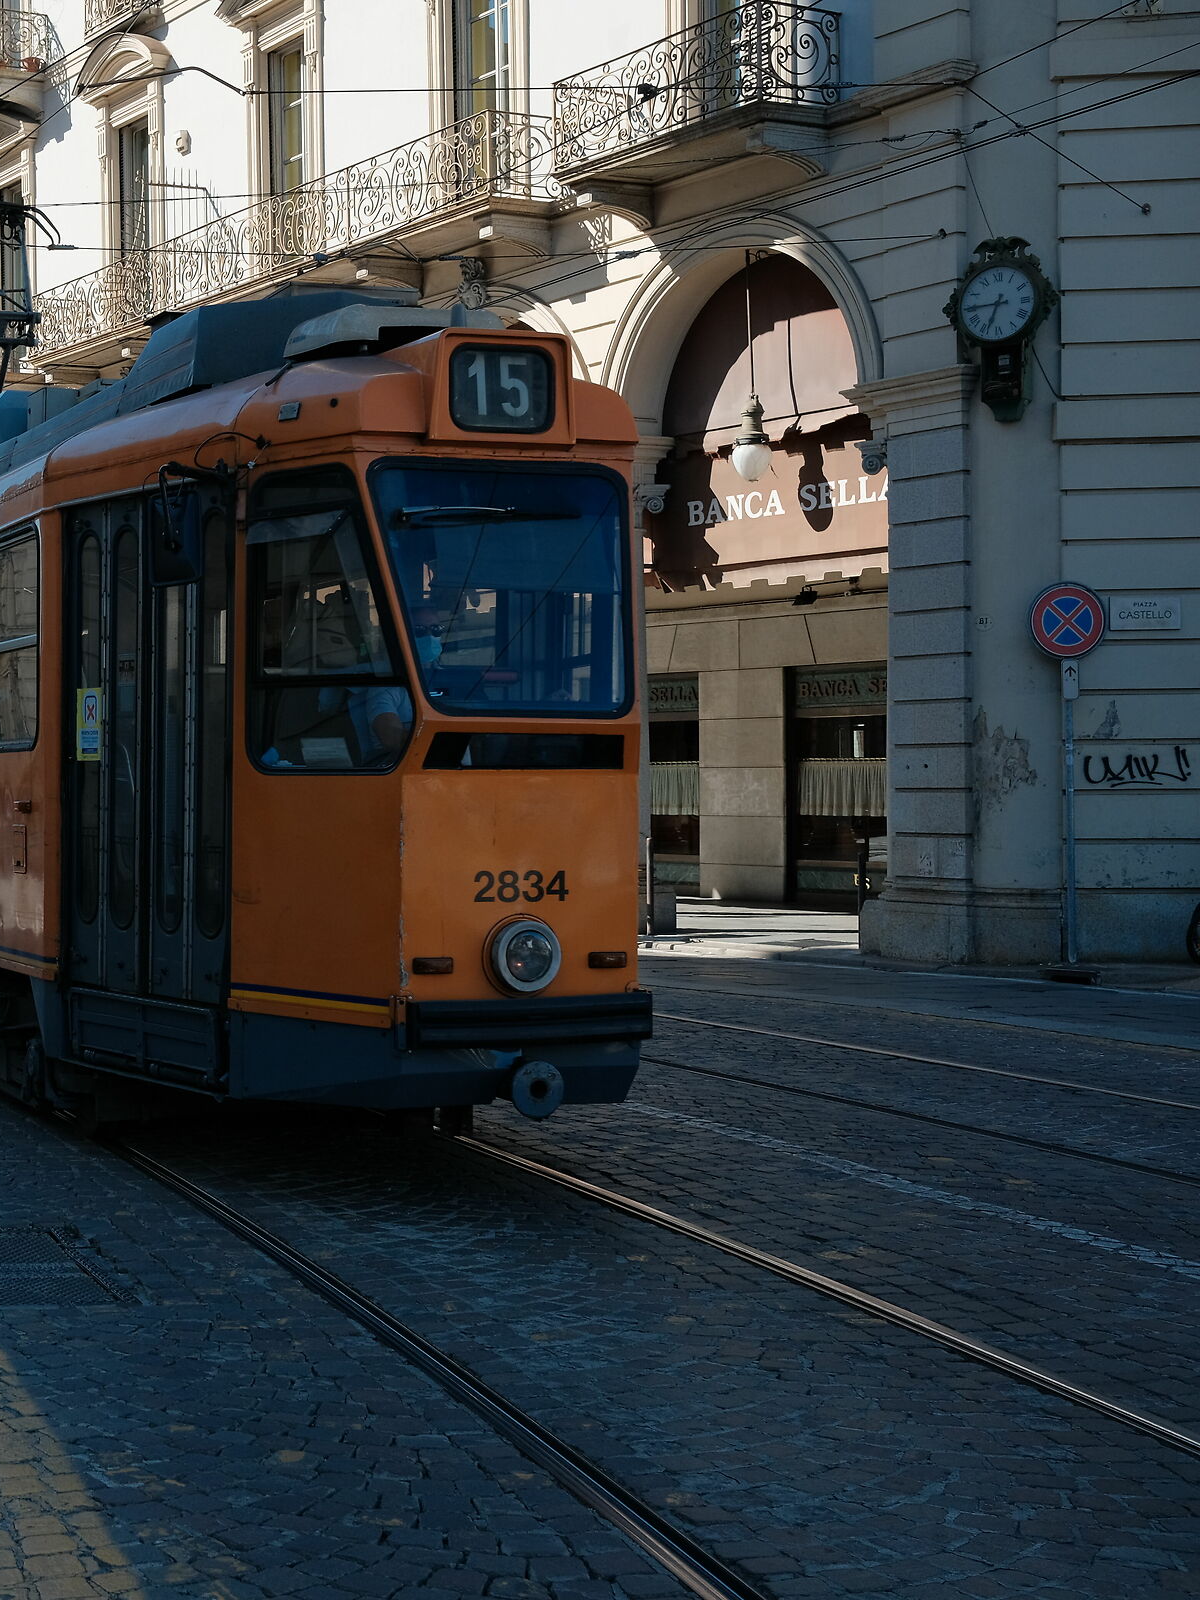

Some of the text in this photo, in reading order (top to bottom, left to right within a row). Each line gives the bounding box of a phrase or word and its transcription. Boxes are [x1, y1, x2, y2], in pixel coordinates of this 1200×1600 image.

[467, 352, 529, 417] 15
[687, 489, 785, 527] BANCA
[1118, 609, 1172, 620] CASTELLO
[650, 684, 699, 702] SELLA
[800, 679, 860, 699] BANCA
[474, 870, 569, 902] 2834
